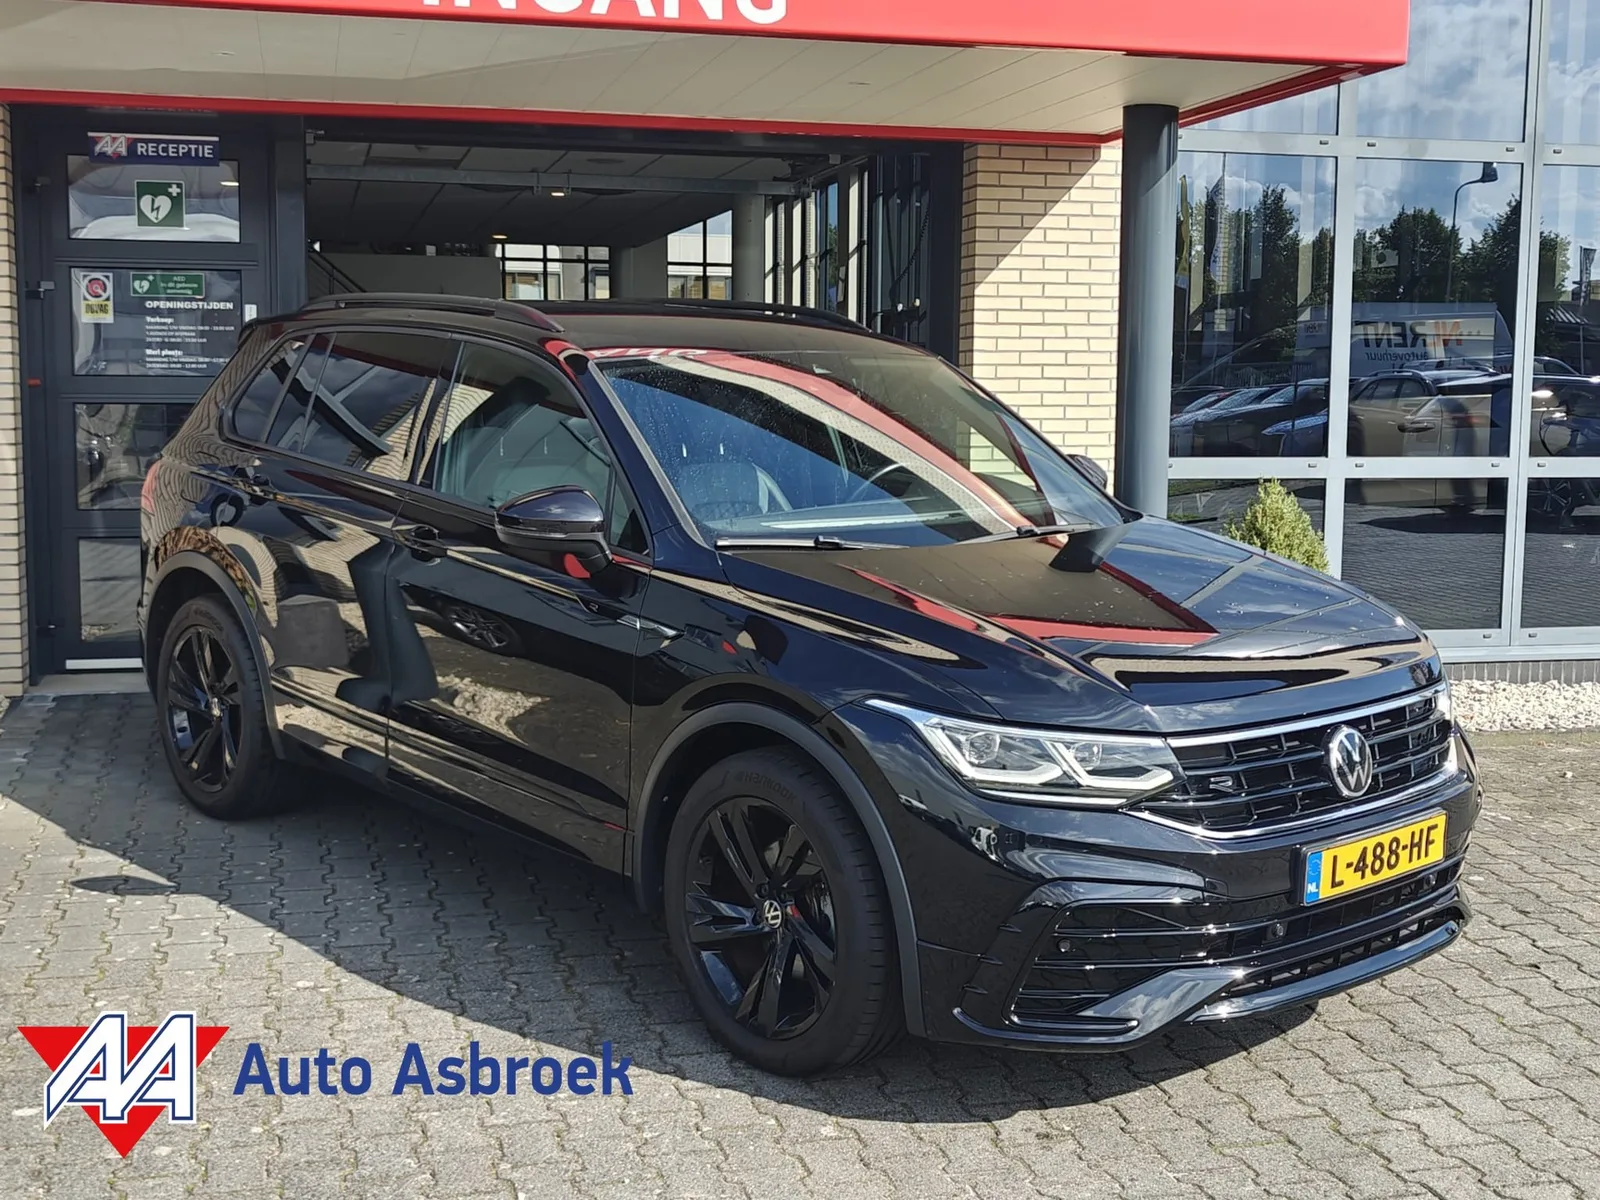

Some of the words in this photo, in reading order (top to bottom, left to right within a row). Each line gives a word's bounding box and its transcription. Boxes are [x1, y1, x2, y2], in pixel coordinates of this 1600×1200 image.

[137, 142, 214, 158] RECEPTIE
[145, 300, 234, 310] OPENINGSTIJDEN
[1330, 823, 1439, 890] L-488-HF
[1306, 882, 1319, 894] NL
